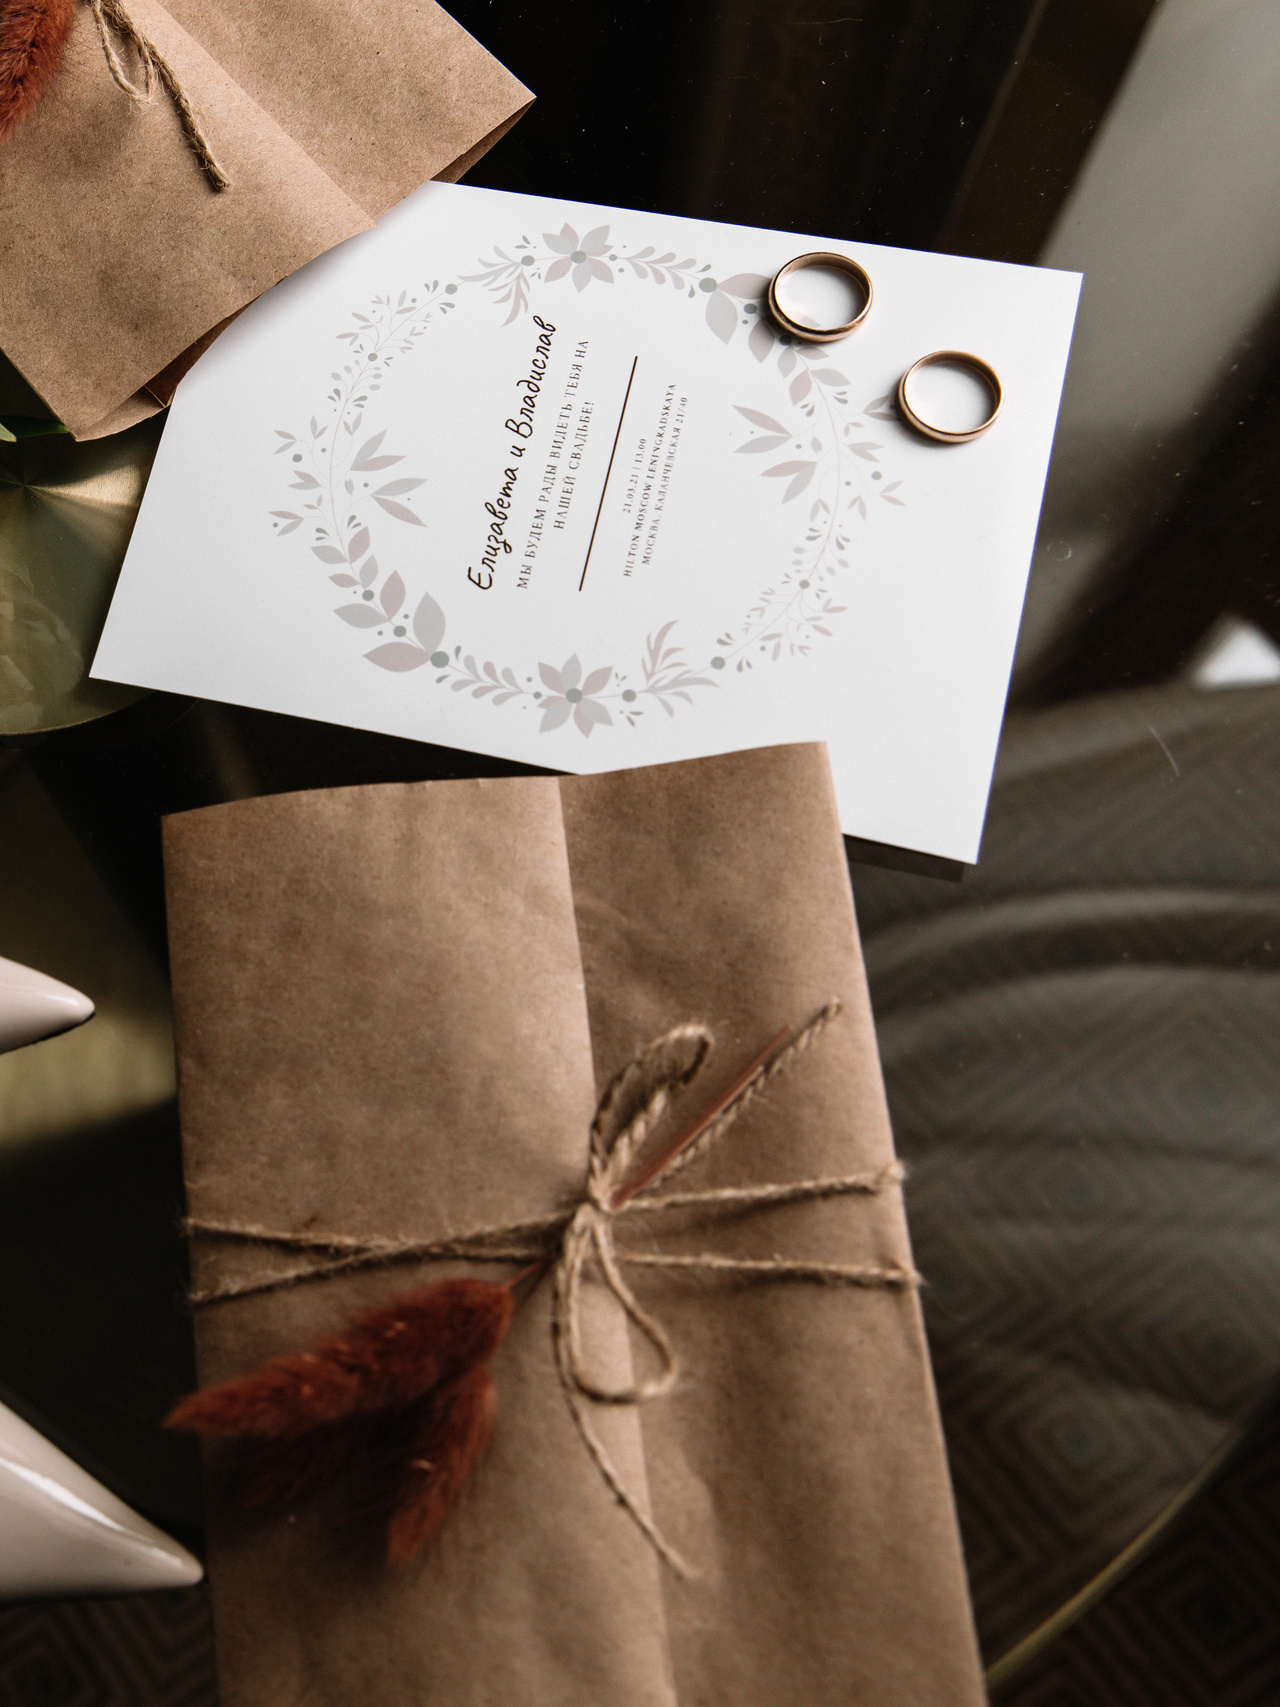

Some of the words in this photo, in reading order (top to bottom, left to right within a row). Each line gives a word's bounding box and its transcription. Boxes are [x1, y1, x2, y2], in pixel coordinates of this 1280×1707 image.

[504, 314, 557, 440] Владислав
[574, 341, 589, 359] НА
[564, 363, 583, 398] ТЕБЯ
[509, 444, 527, 458] и
[549, 403, 573, 459] ВИДЕТЬ
[654, 427, 682, 511] КАЛАНЧЕВСКАЯ
[675, 397, 688, 424] 21/40
[538, 464, 558, 503] РАДЫ
[553, 475, 576, 530] НАШЕЙ
[568, 401, 594, 470] СВАДЬБЕ!
[622, 474, 639, 514] 21.03.21
[634, 438, 647, 463] 13.00
[623, 534, 640, 577] HILTON
[634, 482, 652, 530] MOSCOW
[646, 384, 676, 479] LENINGRADSKAYA
[466, 466, 520, 591] Елизавета
[524, 508, 547, 559] БУДЕМ
[516, 564, 533, 589] МЫ
